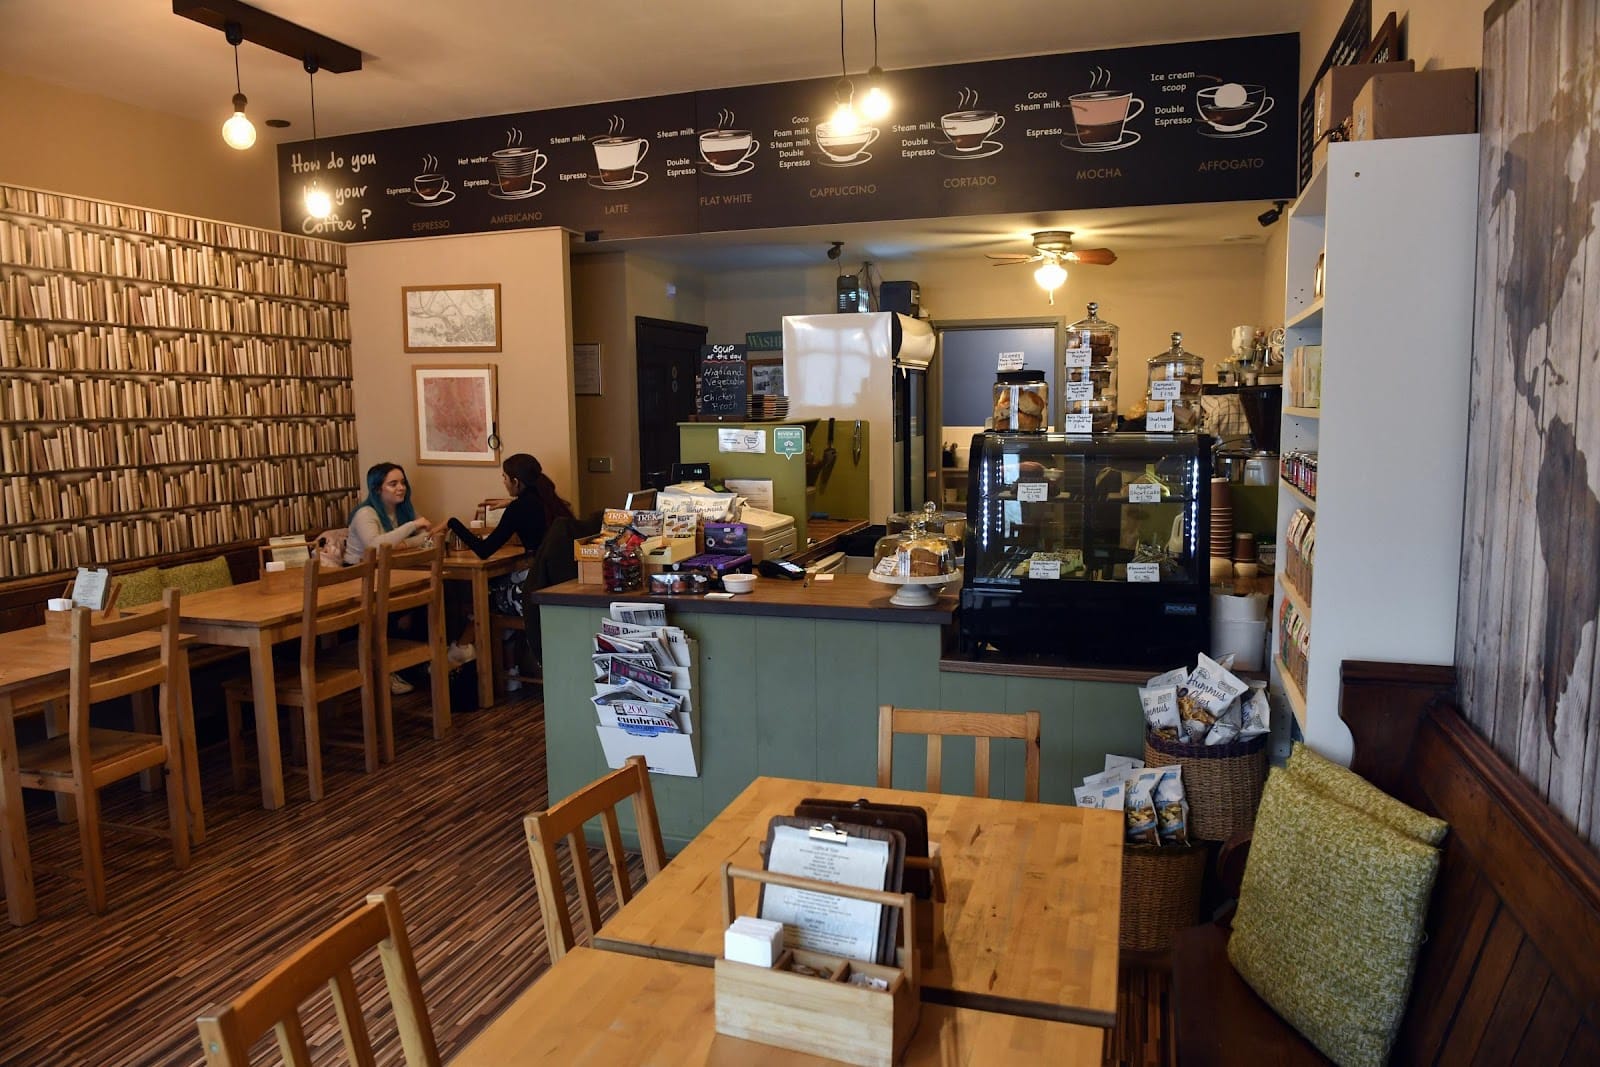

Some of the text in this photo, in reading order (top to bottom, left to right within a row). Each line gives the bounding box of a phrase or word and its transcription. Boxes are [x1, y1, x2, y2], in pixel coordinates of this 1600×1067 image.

[1151, 71, 1195, 81] Ice cream
[1162, 83, 1187, 93] scoop
[1028, 90, 1048, 100] Coco
[1014, 100, 1061, 112] Steam milk
[1154, 105, 1185, 115] Double
[791, 115, 810, 125] Coco
[1154, 115, 1193, 126] Espresso
[773, 127, 810, 138] Foam milk
[892, 122, 936, 133] Steam milk
[1026, 127, 1063, 138] Espresso
[657, 127, 695, 139] Steam milk
[550, 134, 586, 145] Steam milk
[770, 138, 811, 149] Steam milk
[901, 137, 929, 147] Double
[779, 149, 804, 158] Double
[901, 148, 936, 158] Espresso
[291, 151, 377, 174] How do you
[457, 156, 489, 166] Hot water
[666, 157, 690, 167] Double
[779, 159, 811, 168] Espresso
[1198, 158, 1264, 172] AFFOGATO
[559, 172, 587, 182] Espresso
[666, 167, 696, 177] Espresso
[1076, 167, 1122, 181] MOCHA
[463, 179, 490, 189] Espresso
[943, 175, 997, 189] CORTADO
[335, 185, 368, 206] your
[386, 186, 412, 196] Espresso
[809, 184, 877, 199] CAPPUCCINO
[700, 193, 753, 207] FLAT WHITE
[604, 204, 629, 215] LATTE
[302, 208, 372, 234] Coffee ?
[490, 211, 543, 225] AMERICANO
[412, 220, 450, 231] ESPRESSO
[712, 345, 735, 353] SOUP
[729, 353, 742, 362] day
[703, 366, 744, 378] Highland
[705, 378, 745, 388] Vegetable
[703, 392, 736, 402] Chicken
[607, 512, 629, 520] TREK
[638, 513, 658, 521] TREK
[1186, 674, 1226, 701] Hummus
